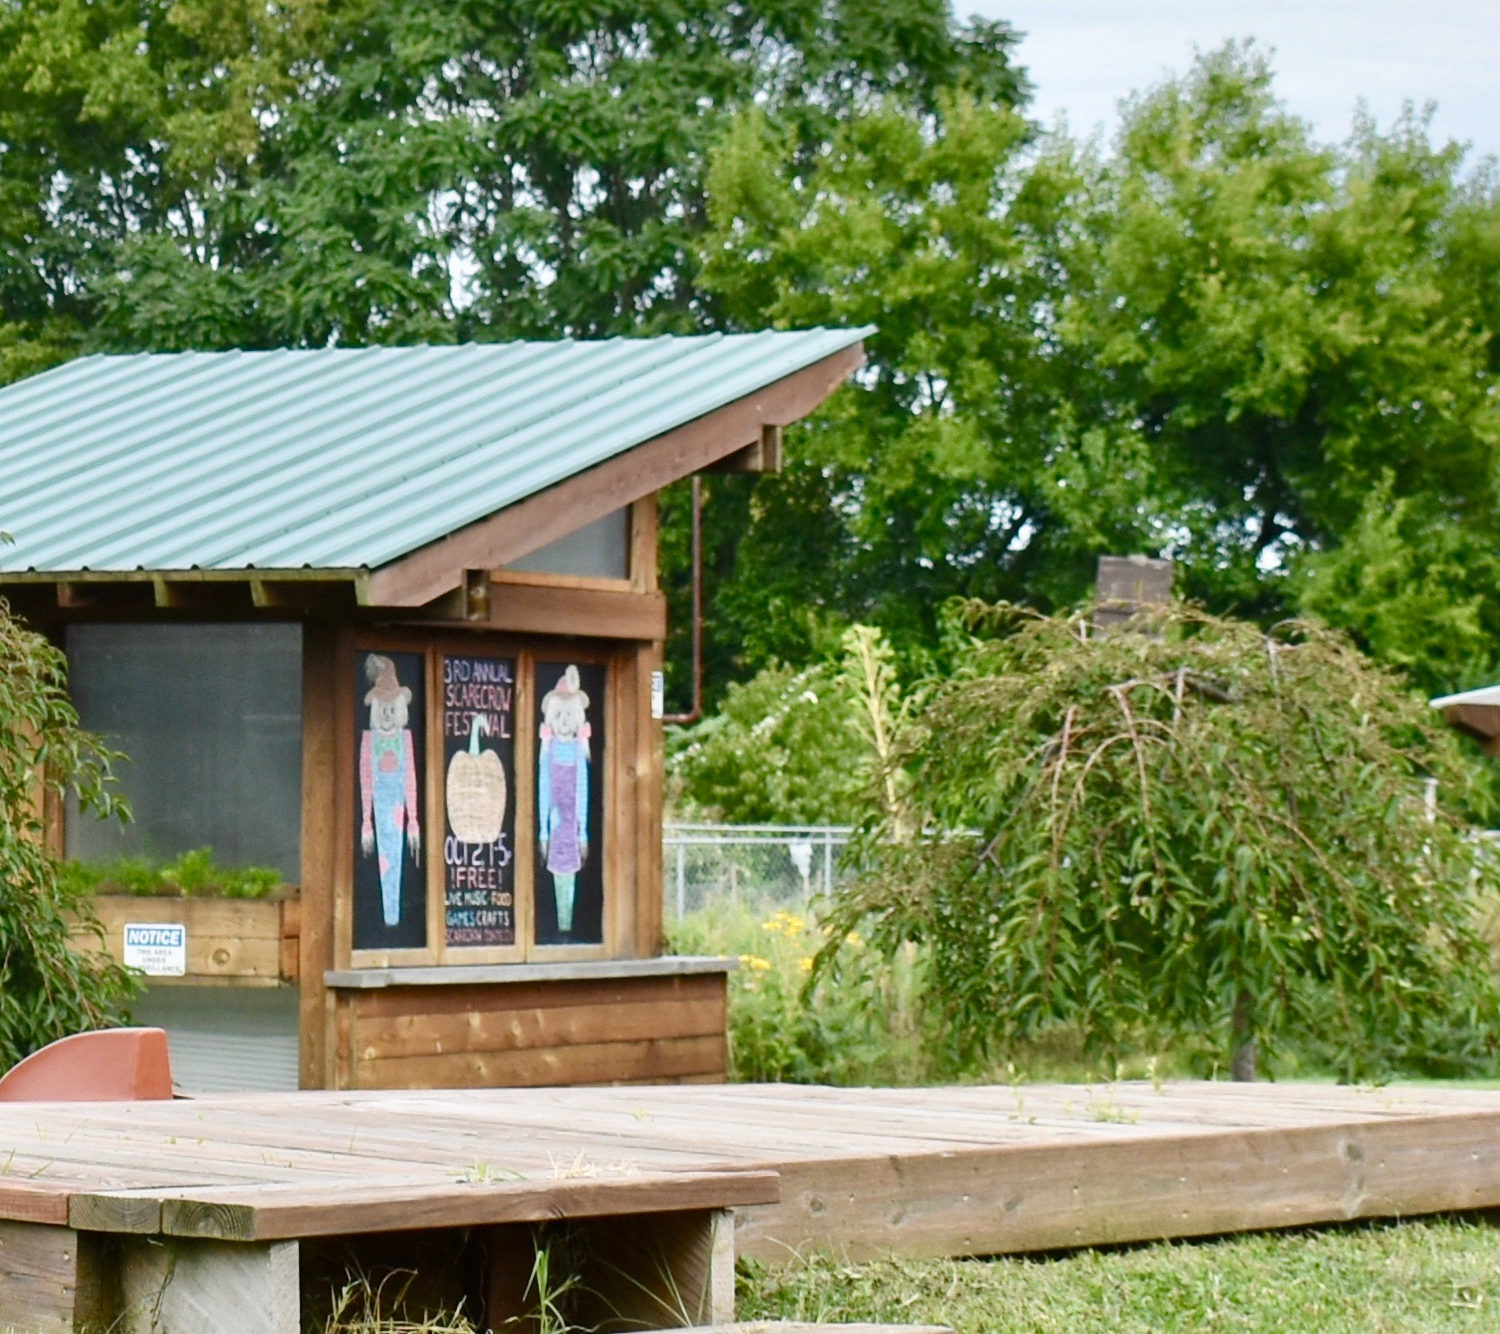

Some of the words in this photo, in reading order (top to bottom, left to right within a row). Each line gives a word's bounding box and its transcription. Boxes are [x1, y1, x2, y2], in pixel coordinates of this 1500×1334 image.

[444, 659, 471, 684] 3RD
[472, 661, 513, 684] ANNUAL
[446, 683, 512, 711] SCARECROW
[444, 891, 463, 906] LIVE
[446, 910, 475, 927] GAMES
[128, 930, 180, 945] NOTICE
